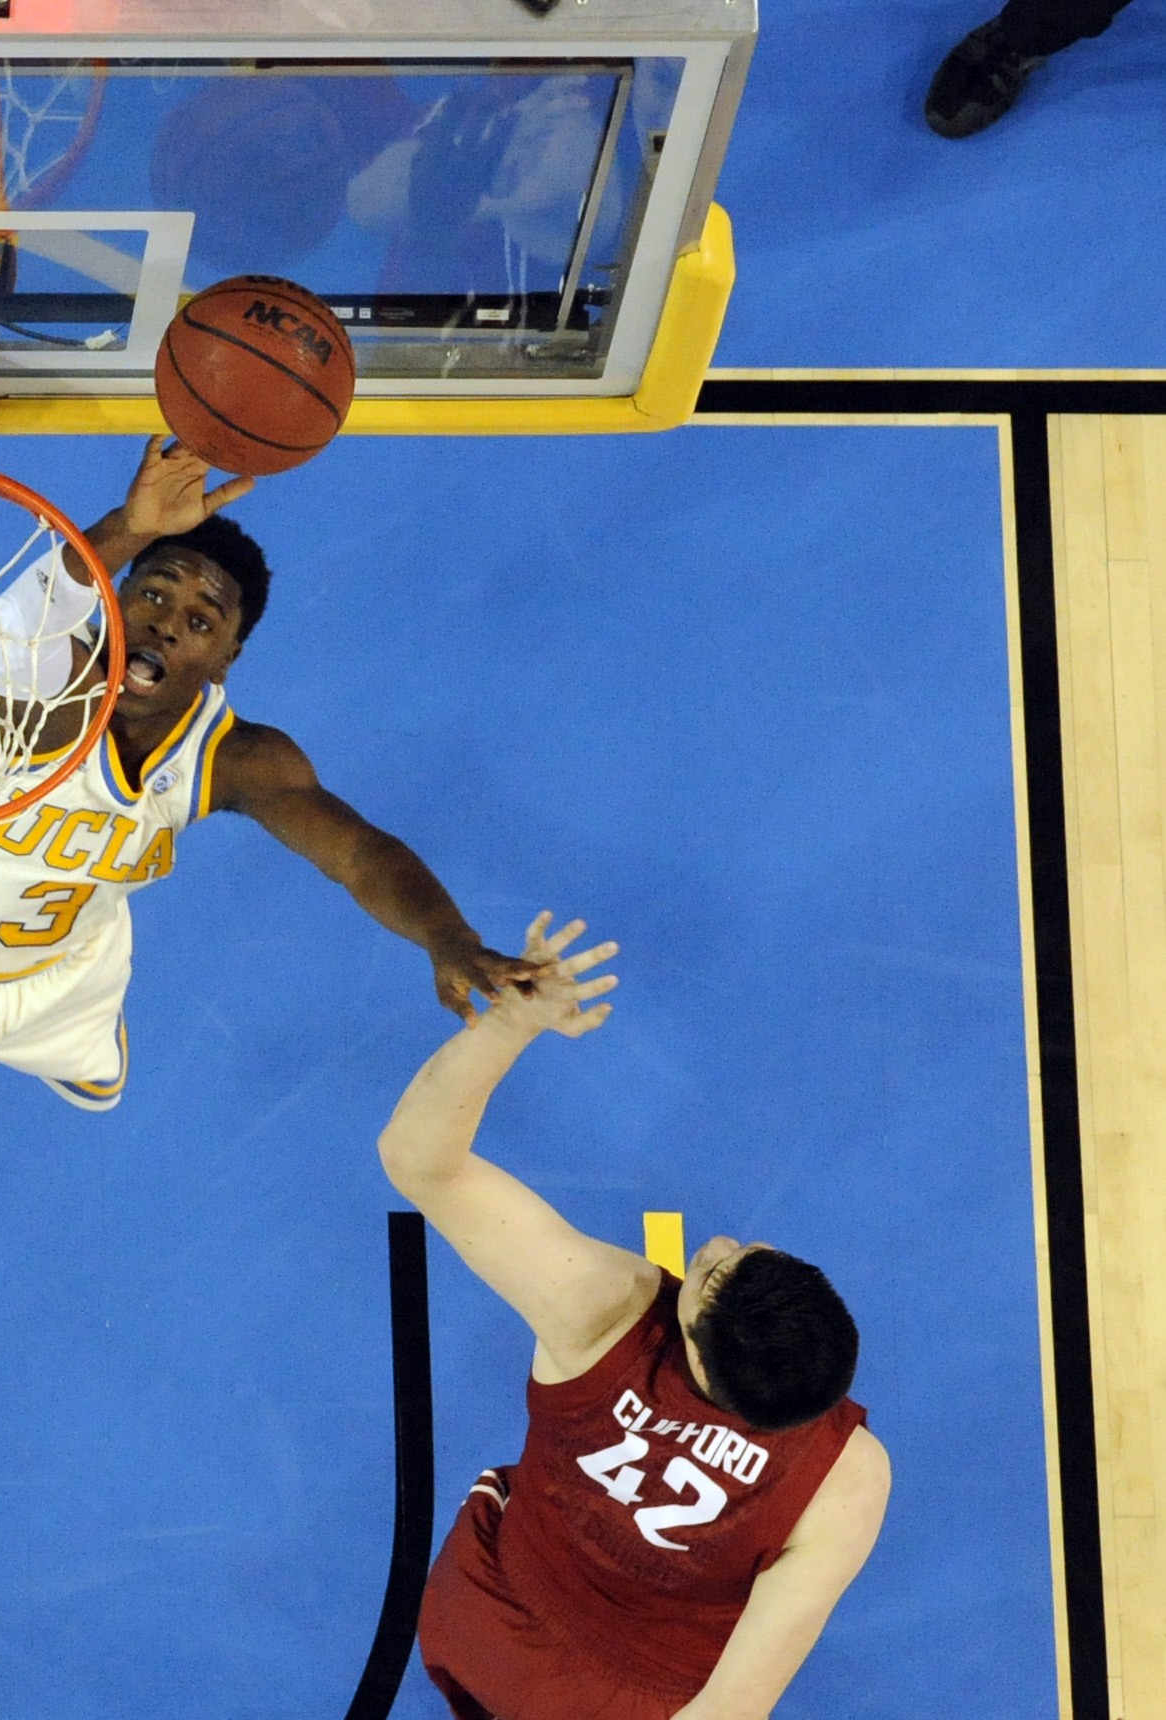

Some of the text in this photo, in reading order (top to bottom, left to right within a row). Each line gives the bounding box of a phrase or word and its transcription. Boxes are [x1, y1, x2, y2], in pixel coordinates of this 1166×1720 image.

[243, 300, 332, 365] NCAA
[612, 1388, 769, 1485] CLIFFORD
[576, 1431, 728, 1551] 42
